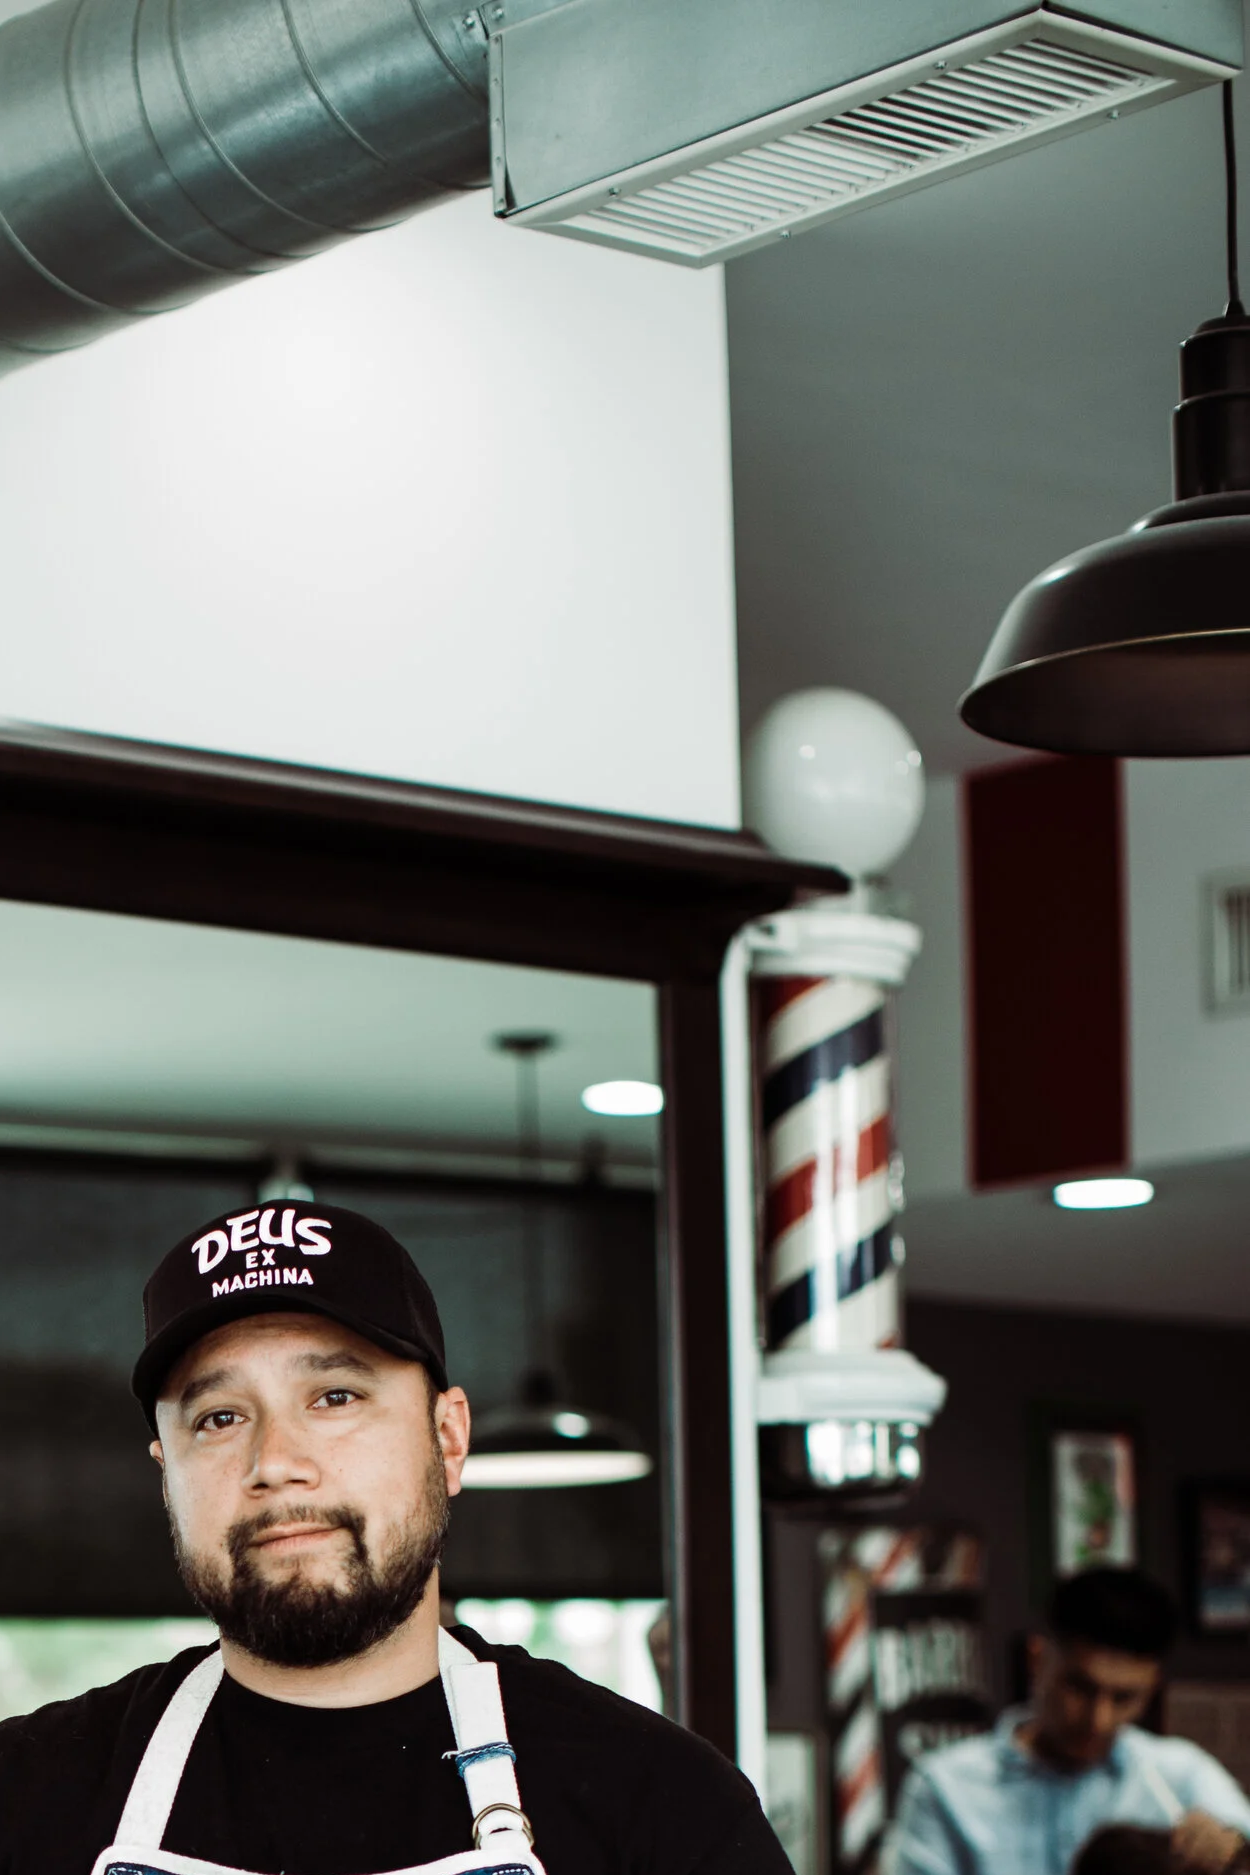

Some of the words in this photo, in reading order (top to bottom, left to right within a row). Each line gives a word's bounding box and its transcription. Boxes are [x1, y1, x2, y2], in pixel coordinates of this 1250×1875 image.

[191, 1208, 332, 1275] DEUS
[245, 1248, 276, 1269] EX
[211, 1267, 314, 1298] MACHINA
